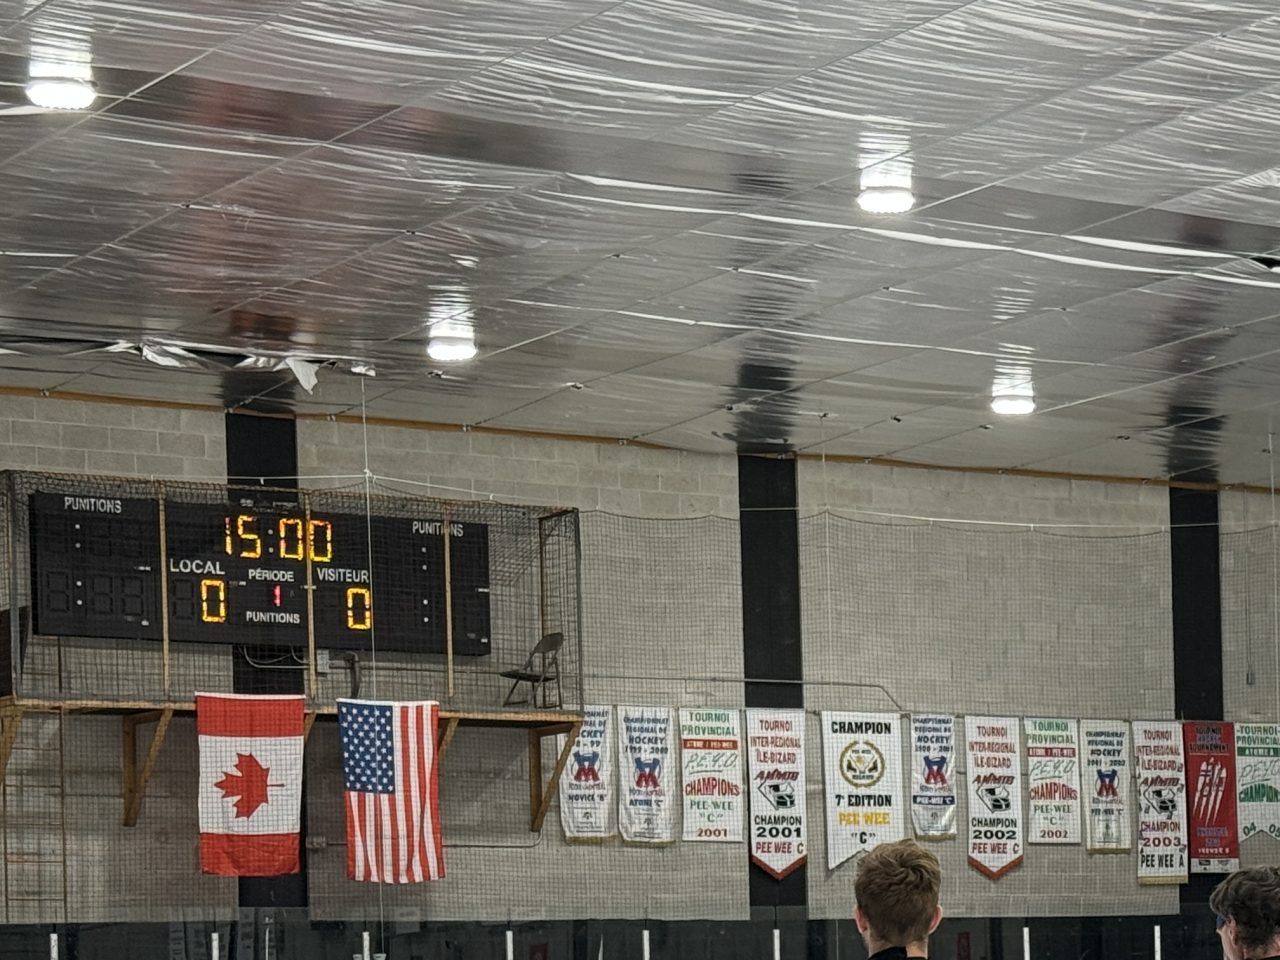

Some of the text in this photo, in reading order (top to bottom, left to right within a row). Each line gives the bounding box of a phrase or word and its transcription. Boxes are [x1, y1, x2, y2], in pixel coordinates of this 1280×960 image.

[64, 496, 122, 514] PUNITIONS
[412, 521, 464, 537] PUNITINS
[225, 515, 332, 562] 15:00
[170, 558, 226, 575] LOCAL
[248, 567, 295, 582] PÉRIODE
[317, 567, 369, 584] VISITEUR
[201, 579, 226, 622] 0
[274, 585, 281, 607] 1
[347, 587, 371, 630] 0
[246, 611, 300, 625] PUNITIONS
[689, 711, 730, 723] TOURNOI
[681, 724, 737, 737] PROVINCIAL
[759, 719, 794, 732] TOURNOI
[830, 721, 892, 735] CHAMPION
[977, 725, 1008, 738] TOURNOI
[1033, 720, 1069, 732] TOURNOI
[1027, 733, 1075, 745] PROVINCIAL
[1143, 729, 1172, 741] TOURNOI
[684, 776, 741, 797] CHAMPIONS
[1029, 782, 1078, 801] CHAMPIONS
[847, 794, 893, 807] EDITION
[753, 814, 803, 826] CHAMPION
[863, 811, 891, 825] WEE
[971, 817, 1017, 828] CHAMPION
[696, 828, 729, 838] 2001
[755, 826, 802, 838] 2001
[1141, 820, 1181, 833] CHAMPION
[1243, 822, 1257, 837] 04
[1268, 823, 1280, 838] 05
[972, 829, 1017, 840] 2002
[1041, 829, 1069, 839] 2002
[755, 841, 804, 855] PEE WEE C
[972, 842, 1020, 855] PEE WEE C
[1142, 836, 1182, 848] 2003
[1140, 853, 1185, 868] PEE WEE A
